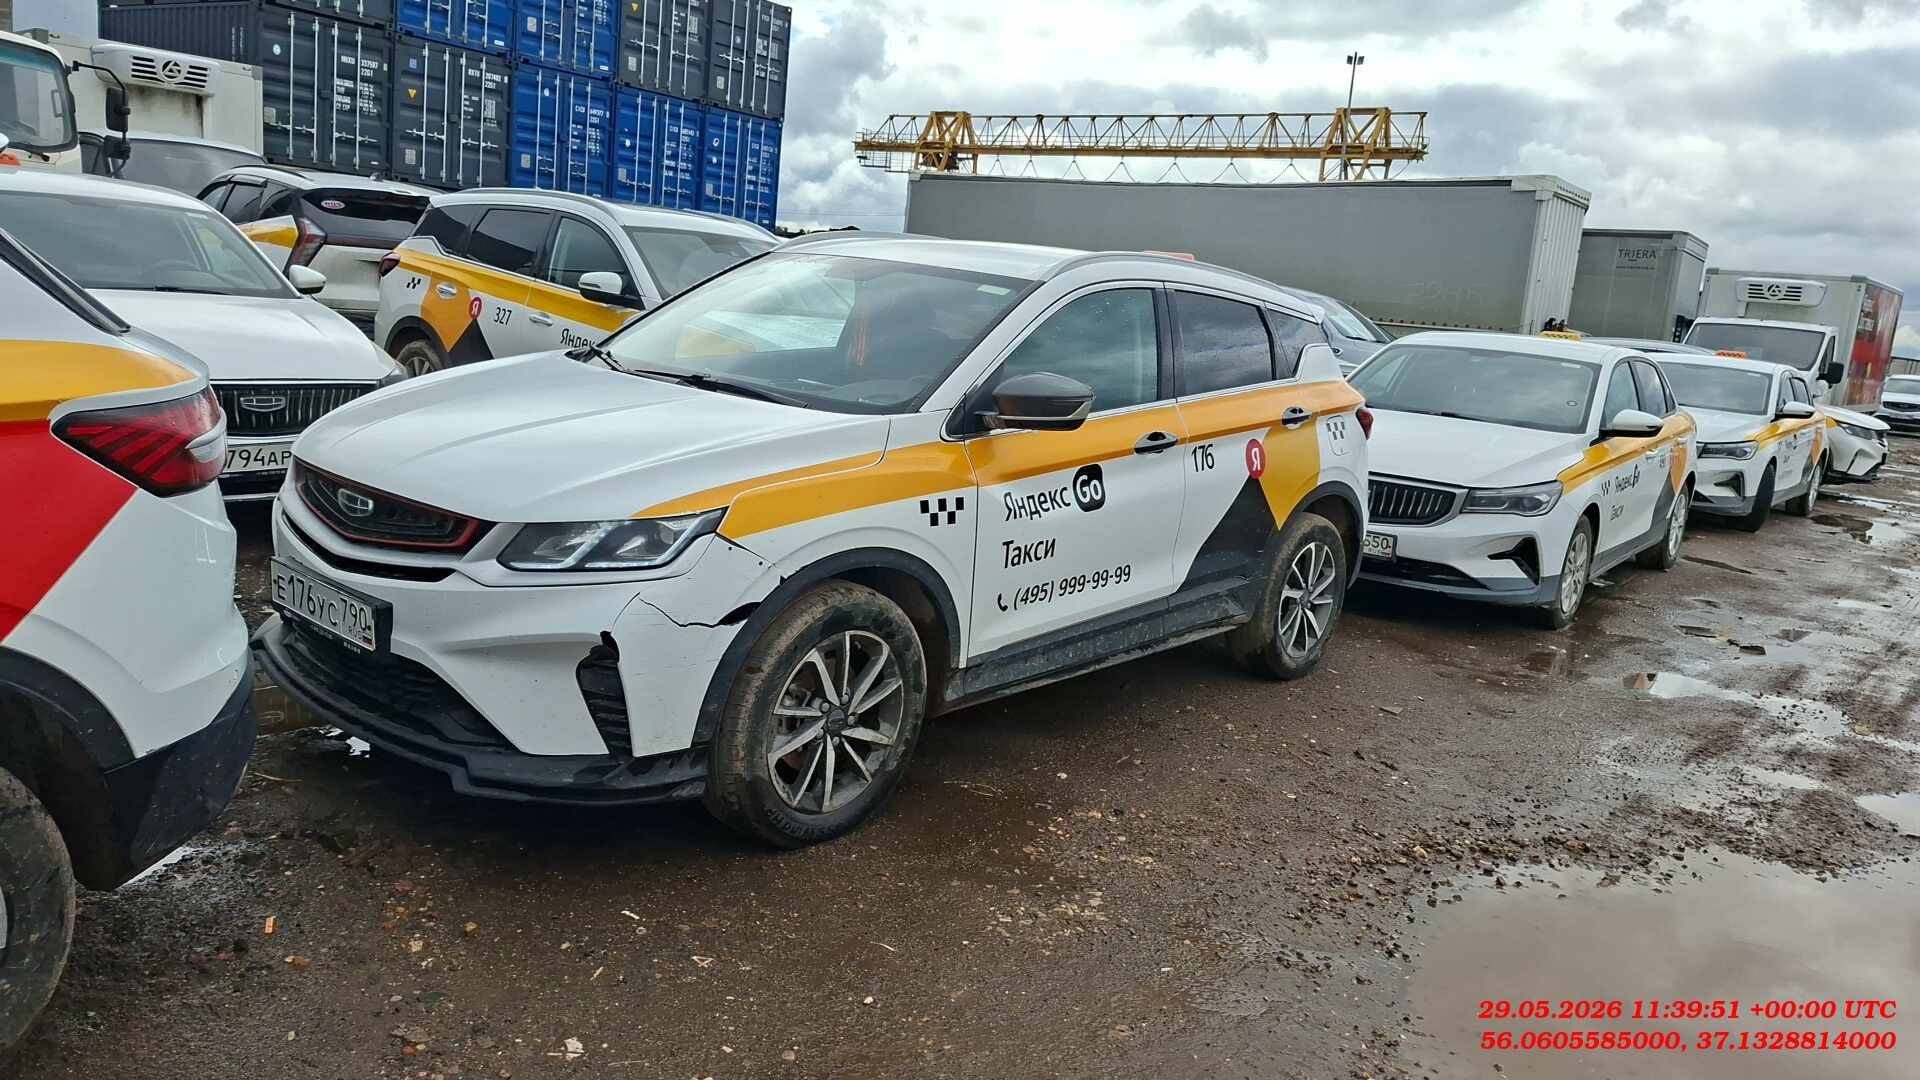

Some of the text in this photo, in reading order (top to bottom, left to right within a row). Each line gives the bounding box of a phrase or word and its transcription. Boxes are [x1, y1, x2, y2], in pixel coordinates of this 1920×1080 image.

[494, 306, 512, 325] 327
[228, 448, 292, 469] 794АР
[1191, 444, 1215, 472] 176
[1004, 486, 1071, 521] Яндекс
[1002, 538, 1056, 569] Такси
[1014, 564, 1131, 611] (495) 999-99-99
